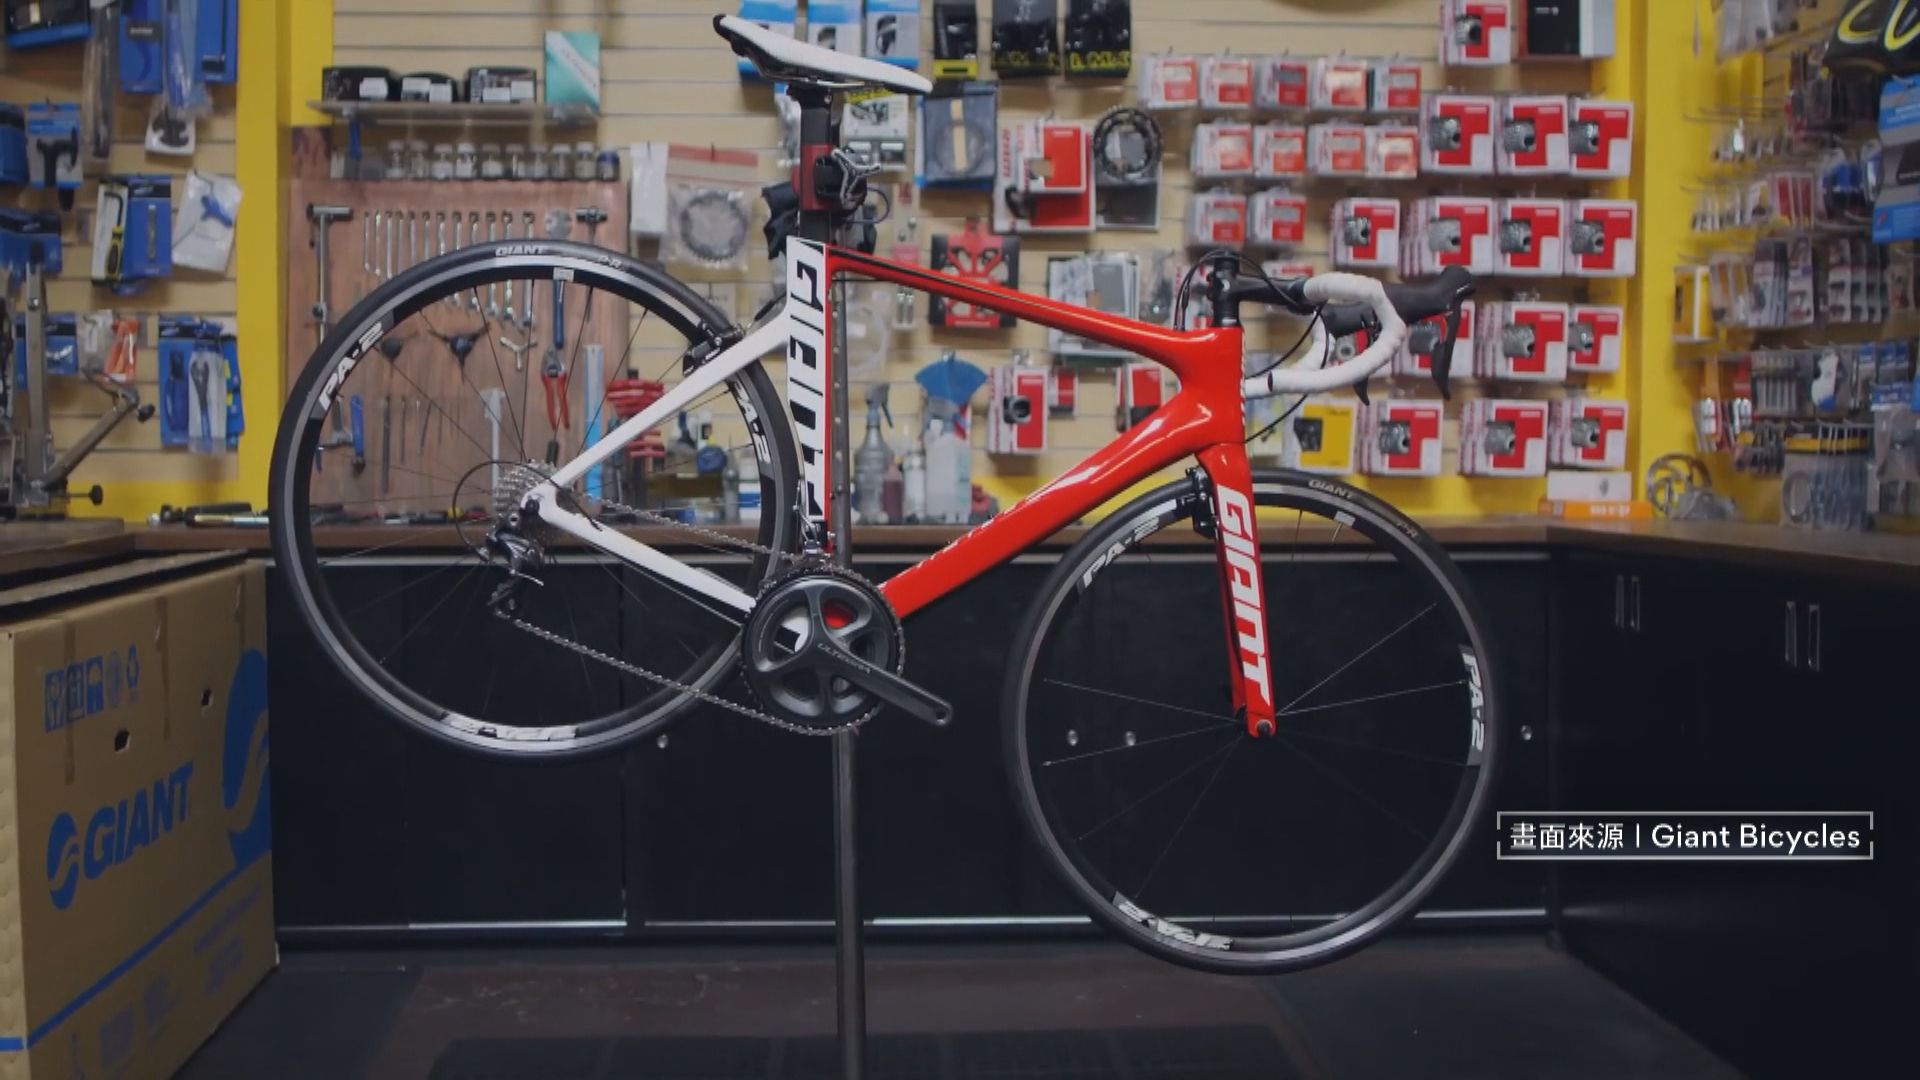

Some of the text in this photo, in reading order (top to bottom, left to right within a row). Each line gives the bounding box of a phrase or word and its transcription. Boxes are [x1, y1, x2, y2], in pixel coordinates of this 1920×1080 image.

[495, 245, 546, 257] GIANT
[319, 321, 384, 411] PA-2
[1308, 480, 1354, 499] GIANT
[1083, 517, 1160, 589] PA-2
[1217, 484, 1270, 706] GIANT
[1462, 652, 1485, 752] PA-2
[83, 760, 193, 880] GIANT
